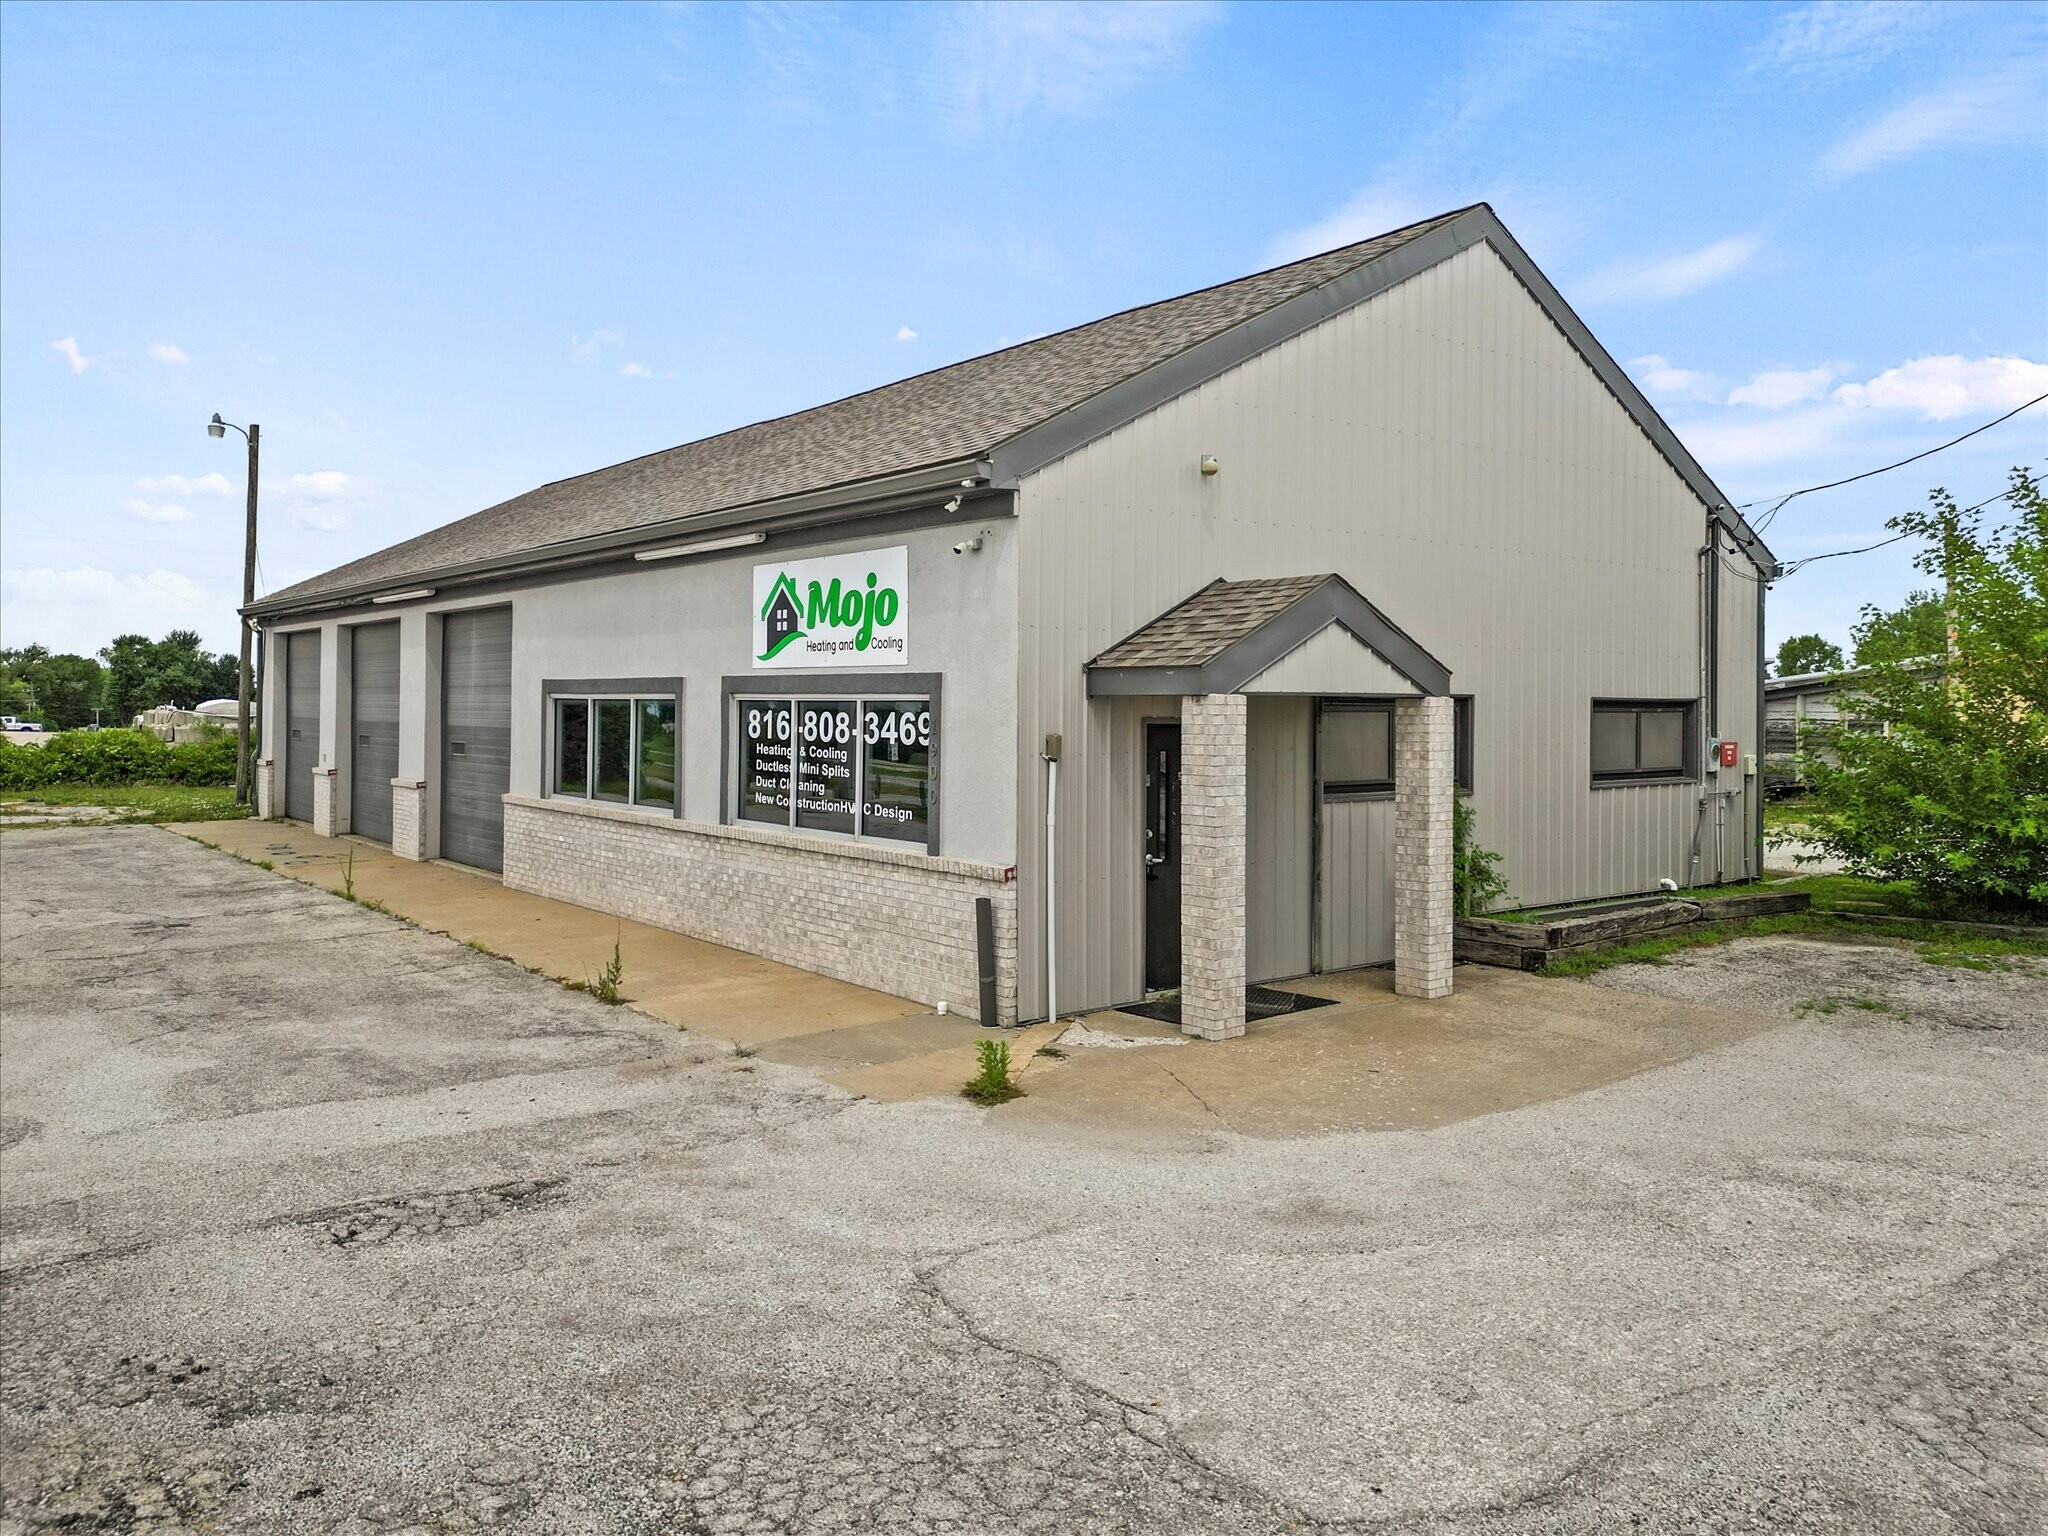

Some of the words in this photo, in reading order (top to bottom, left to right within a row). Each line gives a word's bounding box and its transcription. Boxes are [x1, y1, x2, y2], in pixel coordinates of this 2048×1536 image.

[807, 572, 899, 651] Mojo
[806, 640, 837, 655] Heating
[838, 638, 854, 651] and
[871, 636, 903, 653] Cooling
[756, 742, 792, 760] Heating
[799, 745, 807, 757] &
[809, 745, 848, 763] Cooling
[799, 762, 820, 775] Mini
[821, 763, 850, 779] Splits
[755, 775, 777, 788] Duct
[755, 791, 775, 805] New
[874, 804, 913, 822] Design
